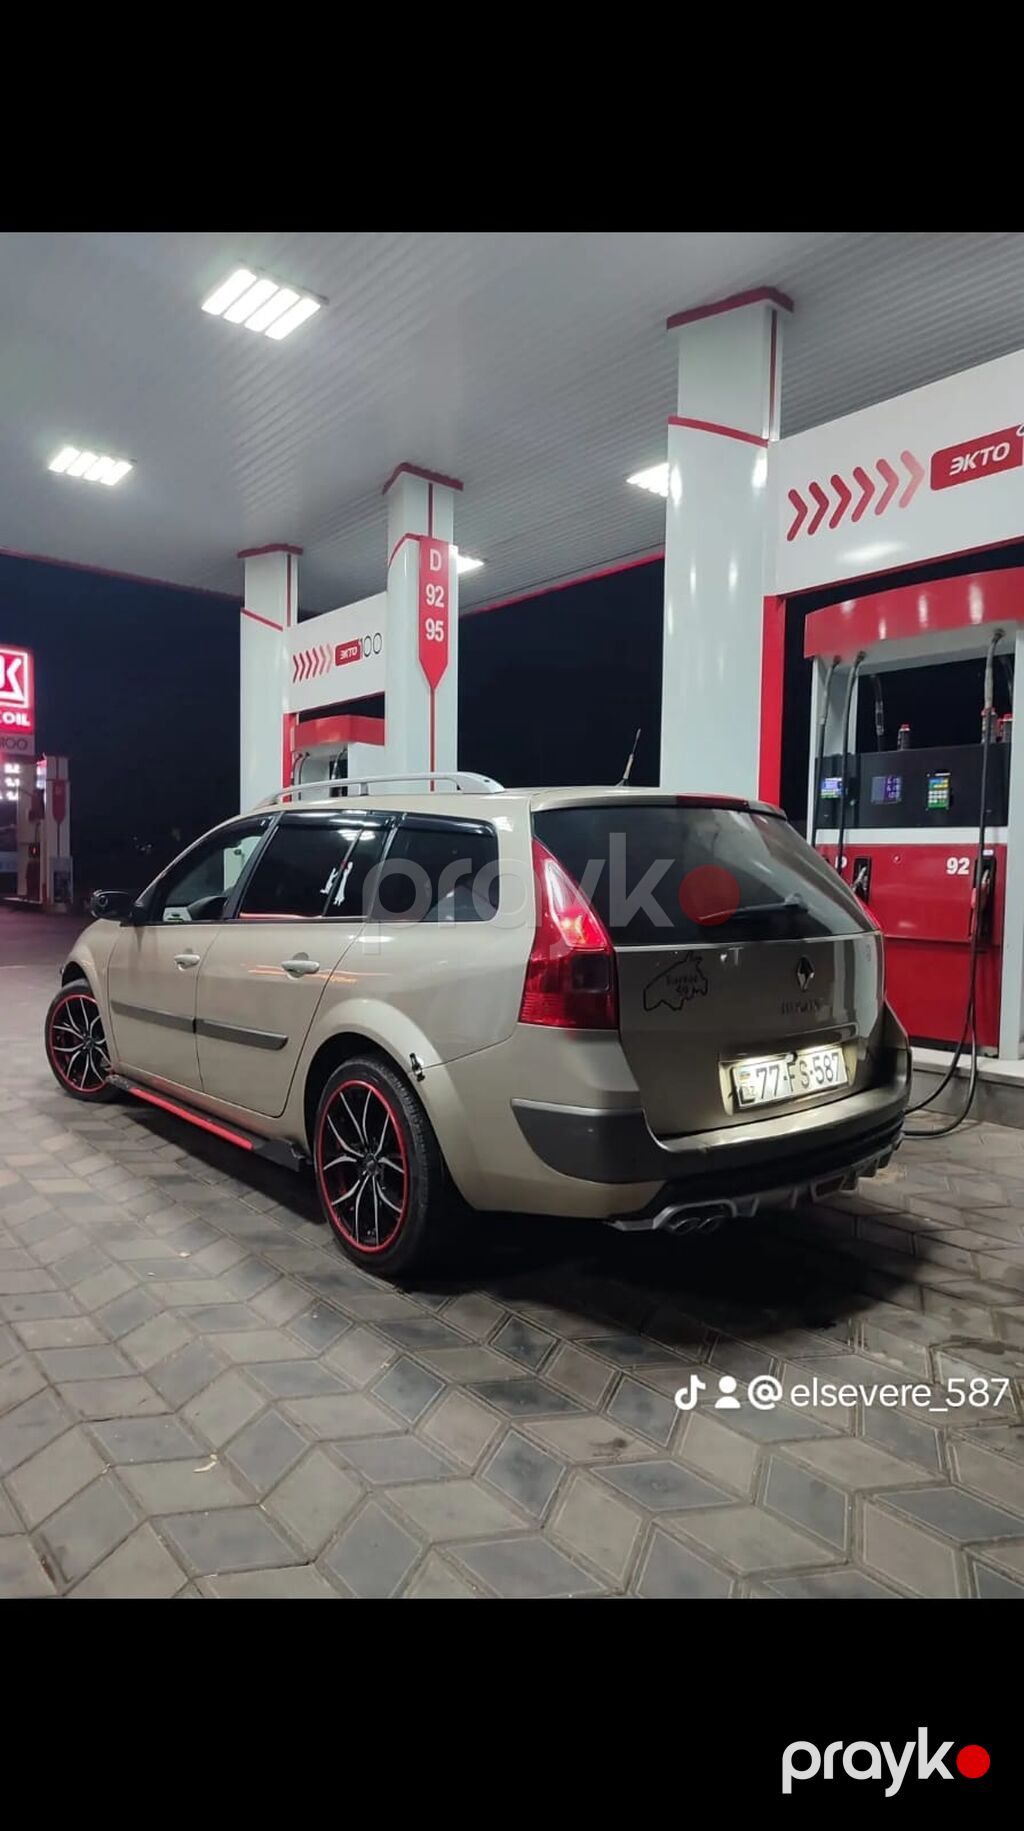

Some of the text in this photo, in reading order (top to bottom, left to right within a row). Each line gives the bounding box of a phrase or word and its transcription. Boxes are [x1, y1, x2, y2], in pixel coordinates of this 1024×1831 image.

[949, 442, 1010, 476] ЭКТО
[429, 549, 442, 571] D
[425, 583, 445, 608] 92
[425, 618, 444, 642] 95
[0, 711, 31, 727] OIL
[946, 857, 970, 875] 92
